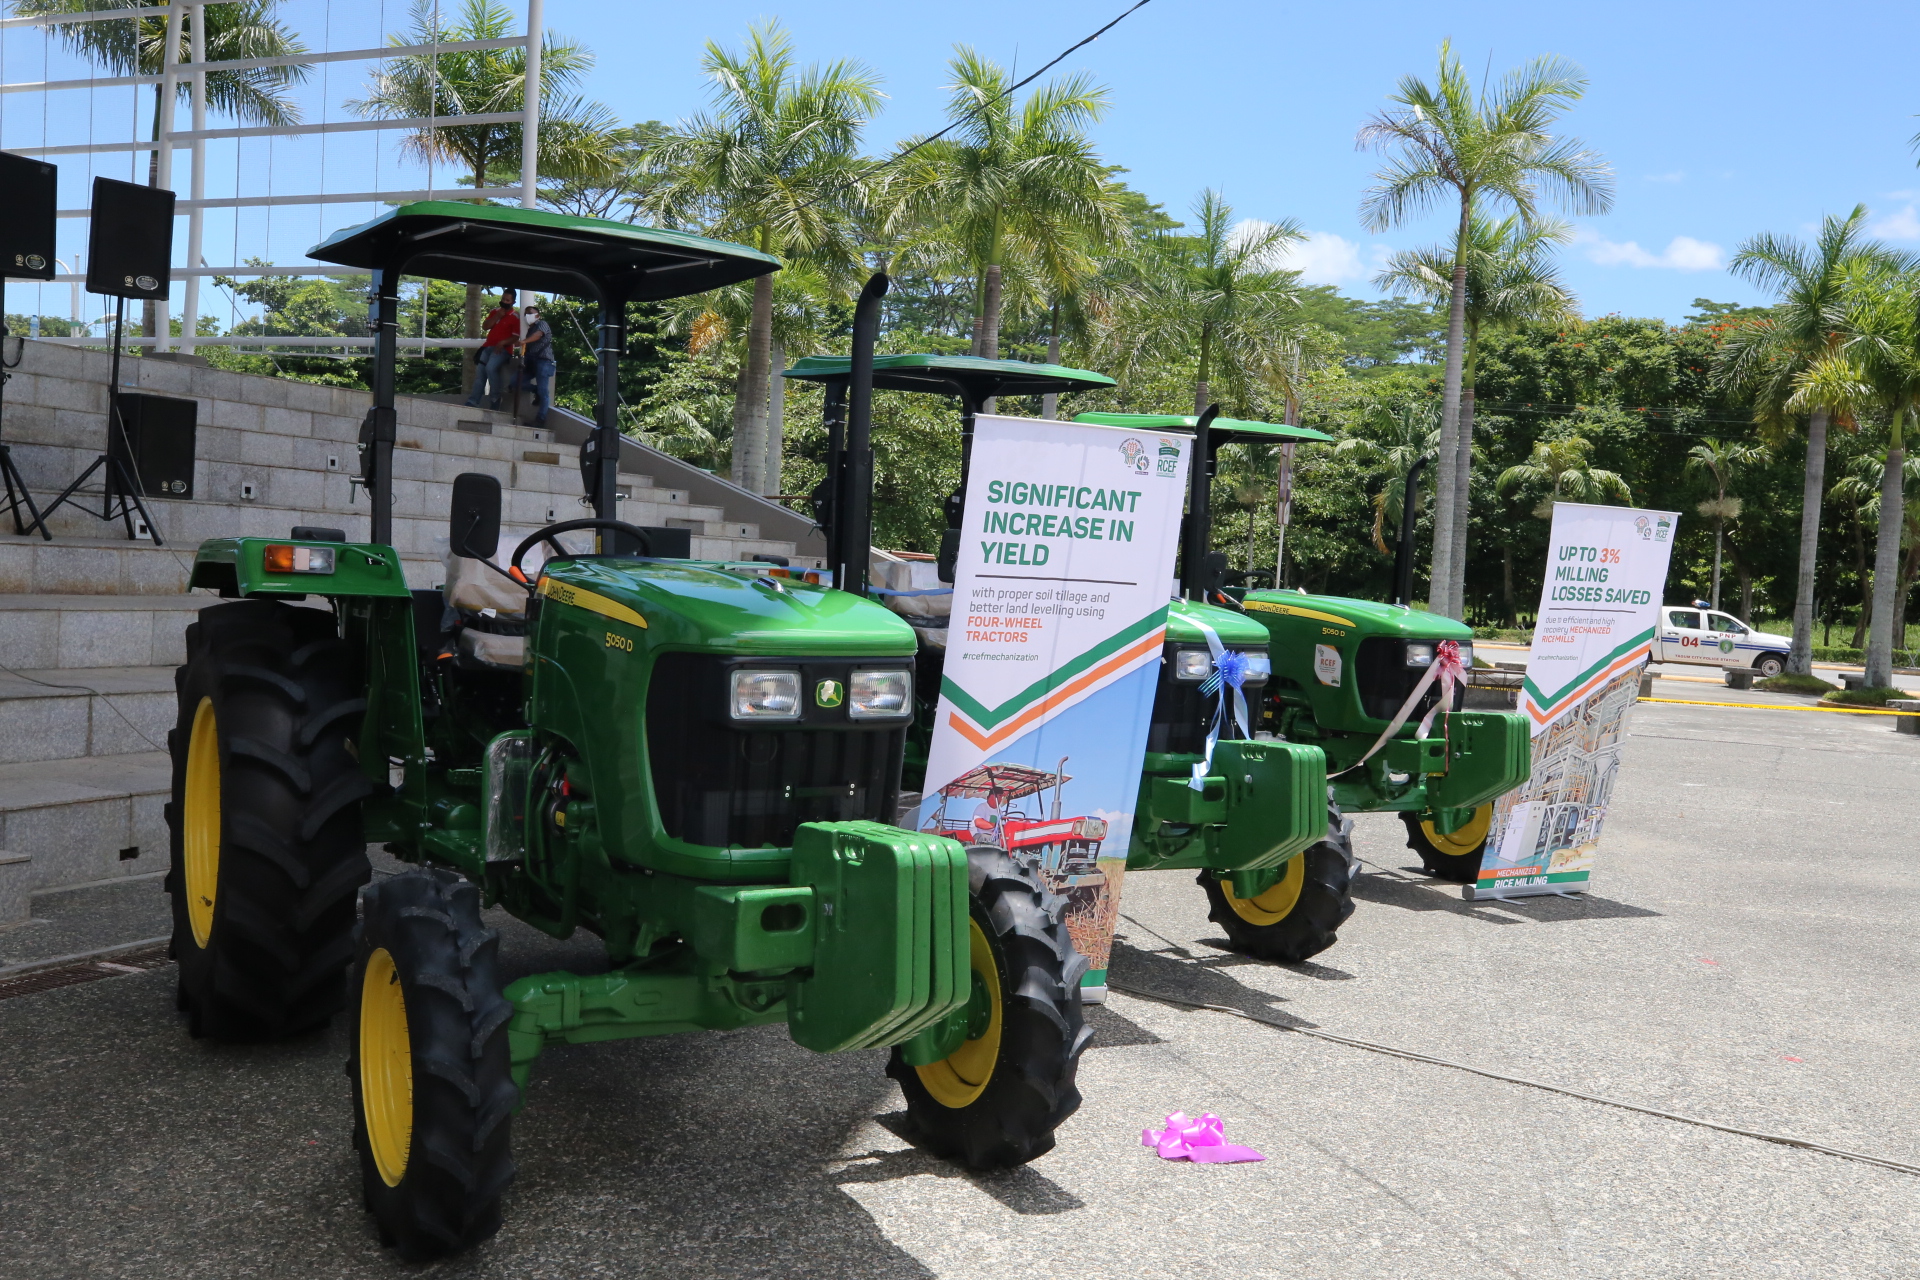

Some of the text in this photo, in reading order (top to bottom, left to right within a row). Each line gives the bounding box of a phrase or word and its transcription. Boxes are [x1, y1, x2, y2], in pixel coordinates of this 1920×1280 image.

[1156, 459, 1178, 473] RCEF
[987, 480, 1142, 513] SIGNIFICANT
[983, 511, 1134, 542] INCREASE IN
[980, 541, 1050, 566] YIELD
[1558, 546, 1621, 564] UP TO 3%
[1555, 565, 1609, 583] MILLING
[972, 586, 1110, 605] with proper soil tillage and
[1551, 585, 1651, 605] LOSSES SAVED
[969, 601, 1105, 621] better land levelling using
[967, 616, 1043, 629] FOUR-WHEEL
[1545, 615, 1557, 624] due
[1562, 615, 1589, 625] efficient
[1589, 616, 1601, 625] and
[1601, 617, 1616, 627] high
[966, 630, 1029, 643] TRACTORS
[1322, 627, 1339, 636] 5050
[1569, 626, 1611, 635] MECHANIZED
[605, 631, 633, 652] 5050 D
[1681, 636, 1699, 648] 04
[962, 652, 1039, 662] #rcefmechanization
[1320, 658, 1336, 667] RCEF
[1496, 867, 1537, 878] MECHANIZED
[1493, 876, 1548, 889] RICE MILLING
